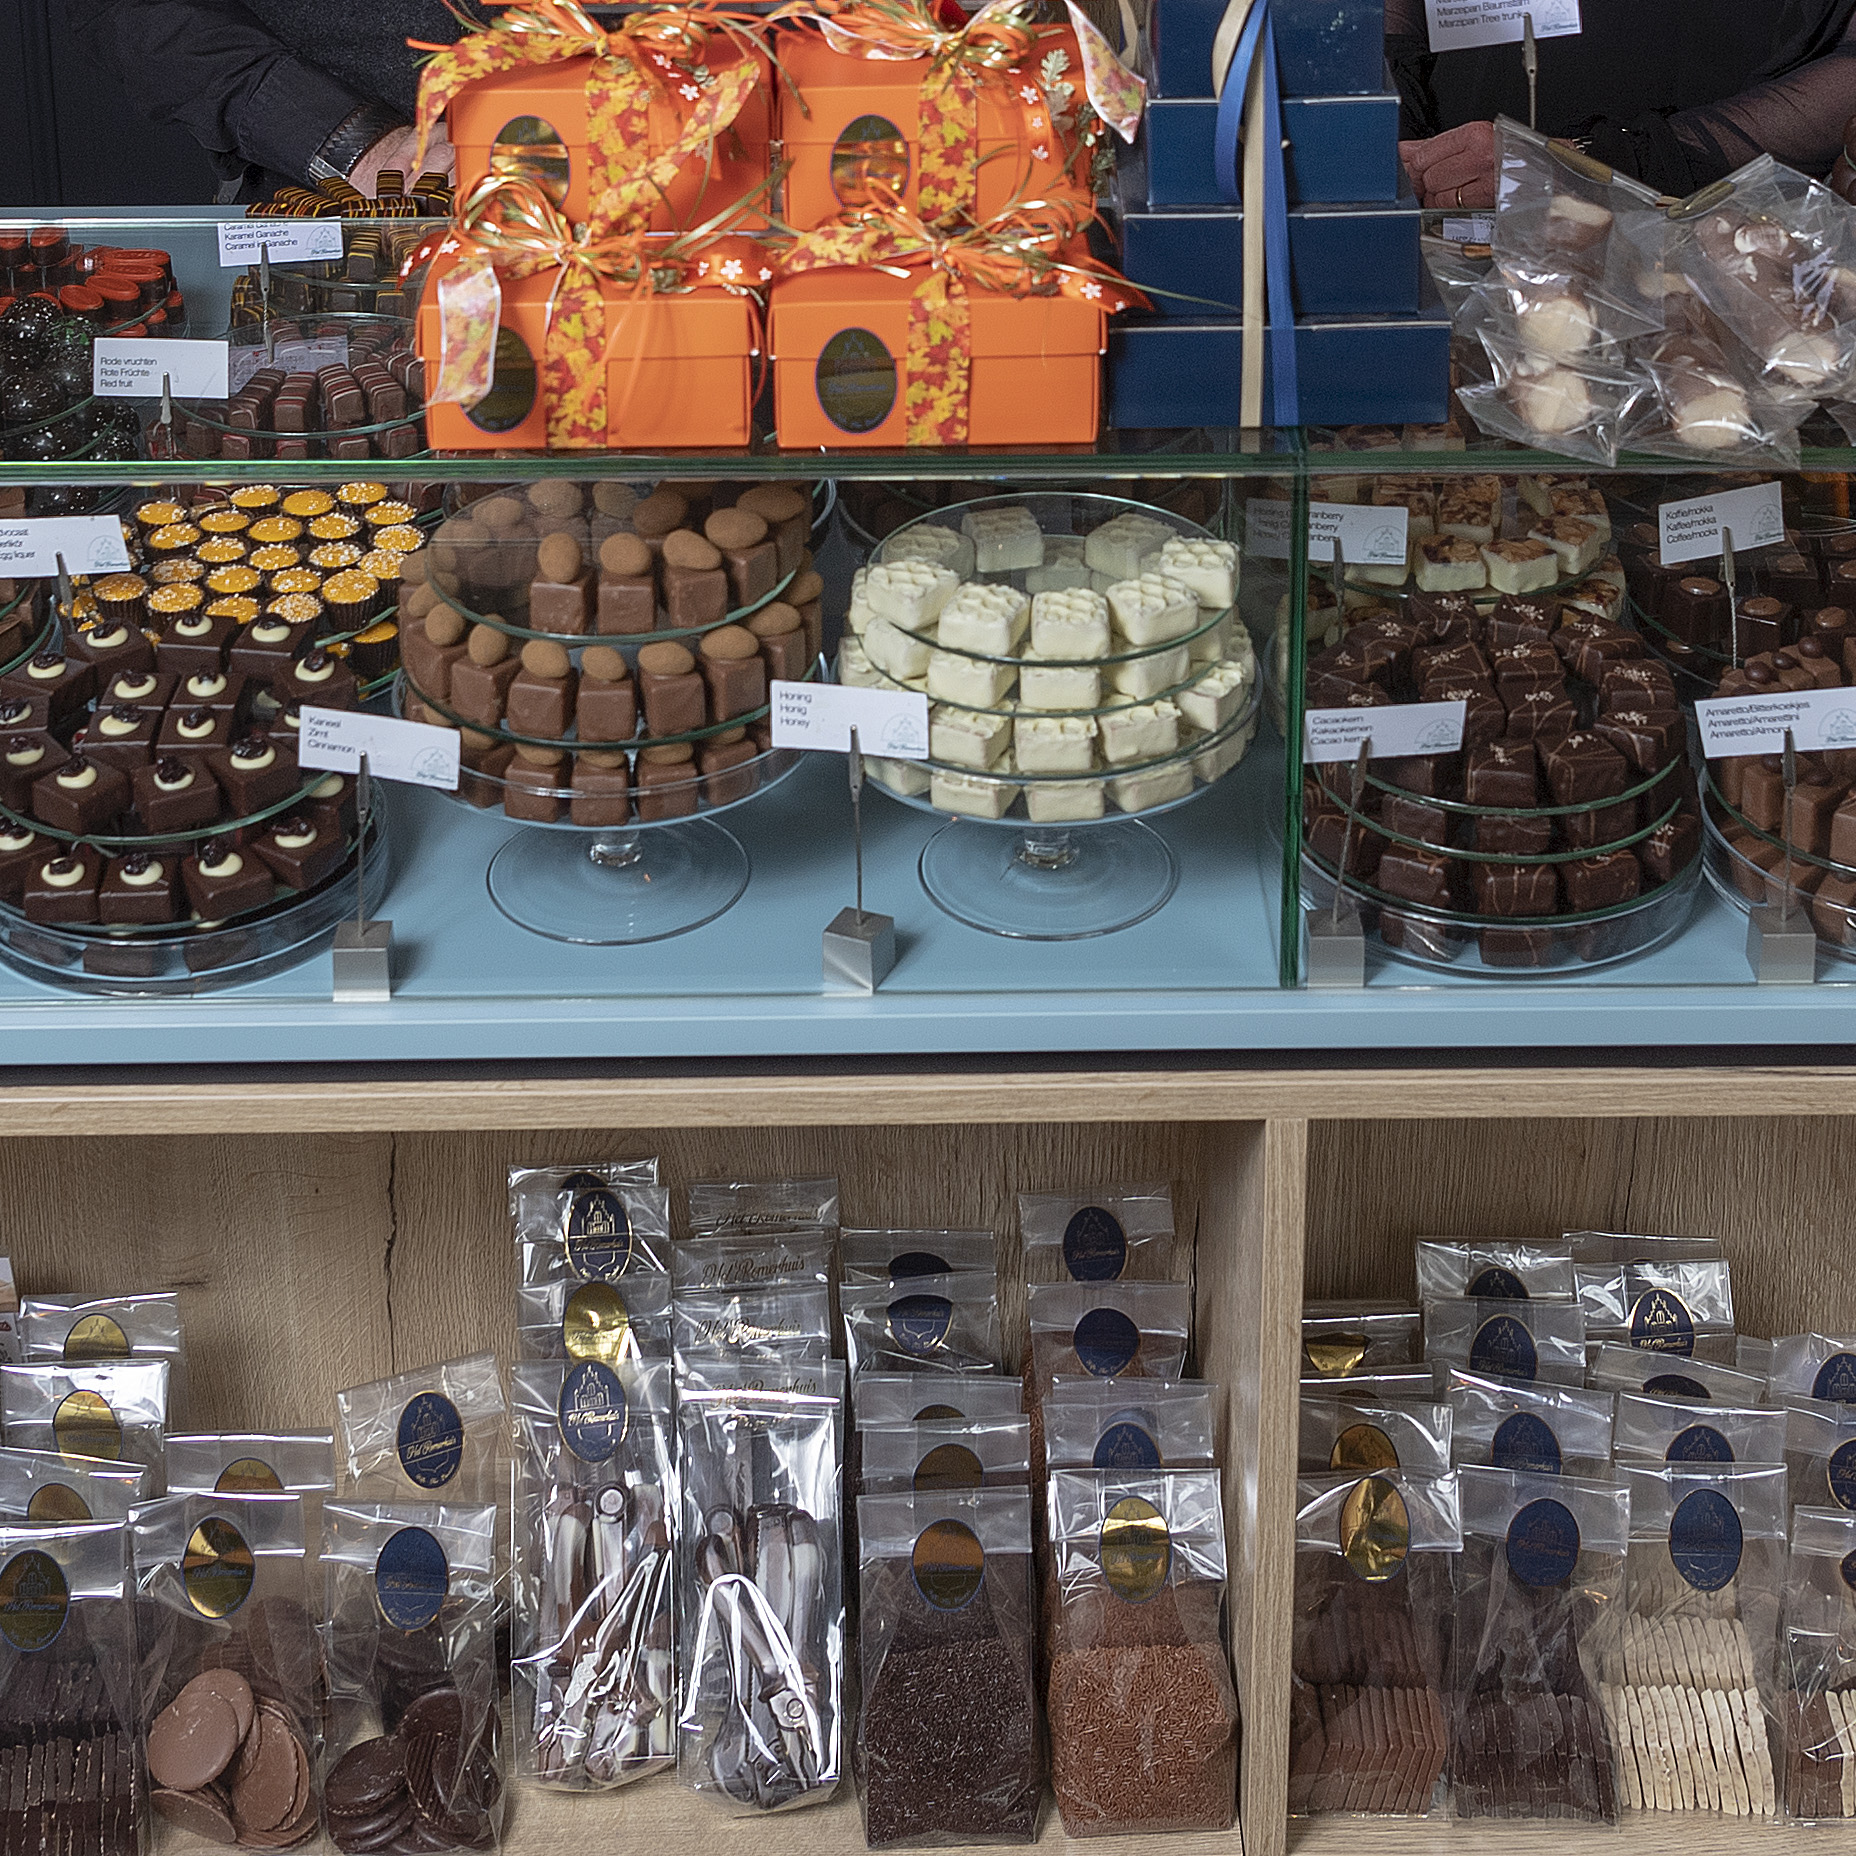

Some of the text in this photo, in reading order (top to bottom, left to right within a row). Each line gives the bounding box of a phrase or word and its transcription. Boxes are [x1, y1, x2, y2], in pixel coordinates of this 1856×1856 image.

[1480, 14, 1500, 24] Tree
[224, 229, 289, 241] Karamel Ganache
[225, 239, 298, 251] Caramel Ganache
[101, 357, 157, 366] Rode vruchten
[101, 368, 150, 377] Rote Früchte
[101, 379, 133, 387] Red fruit
[779, 691, 812, 703] Honing
[779, 704, 808, 715] Honig
[310, 717, 342, 729] Kaneel
[779, 717, 810, 728] Honey
[1311, 736, 1342, 745] Cacao
[308, 739, 356, 754] Cinnamon
